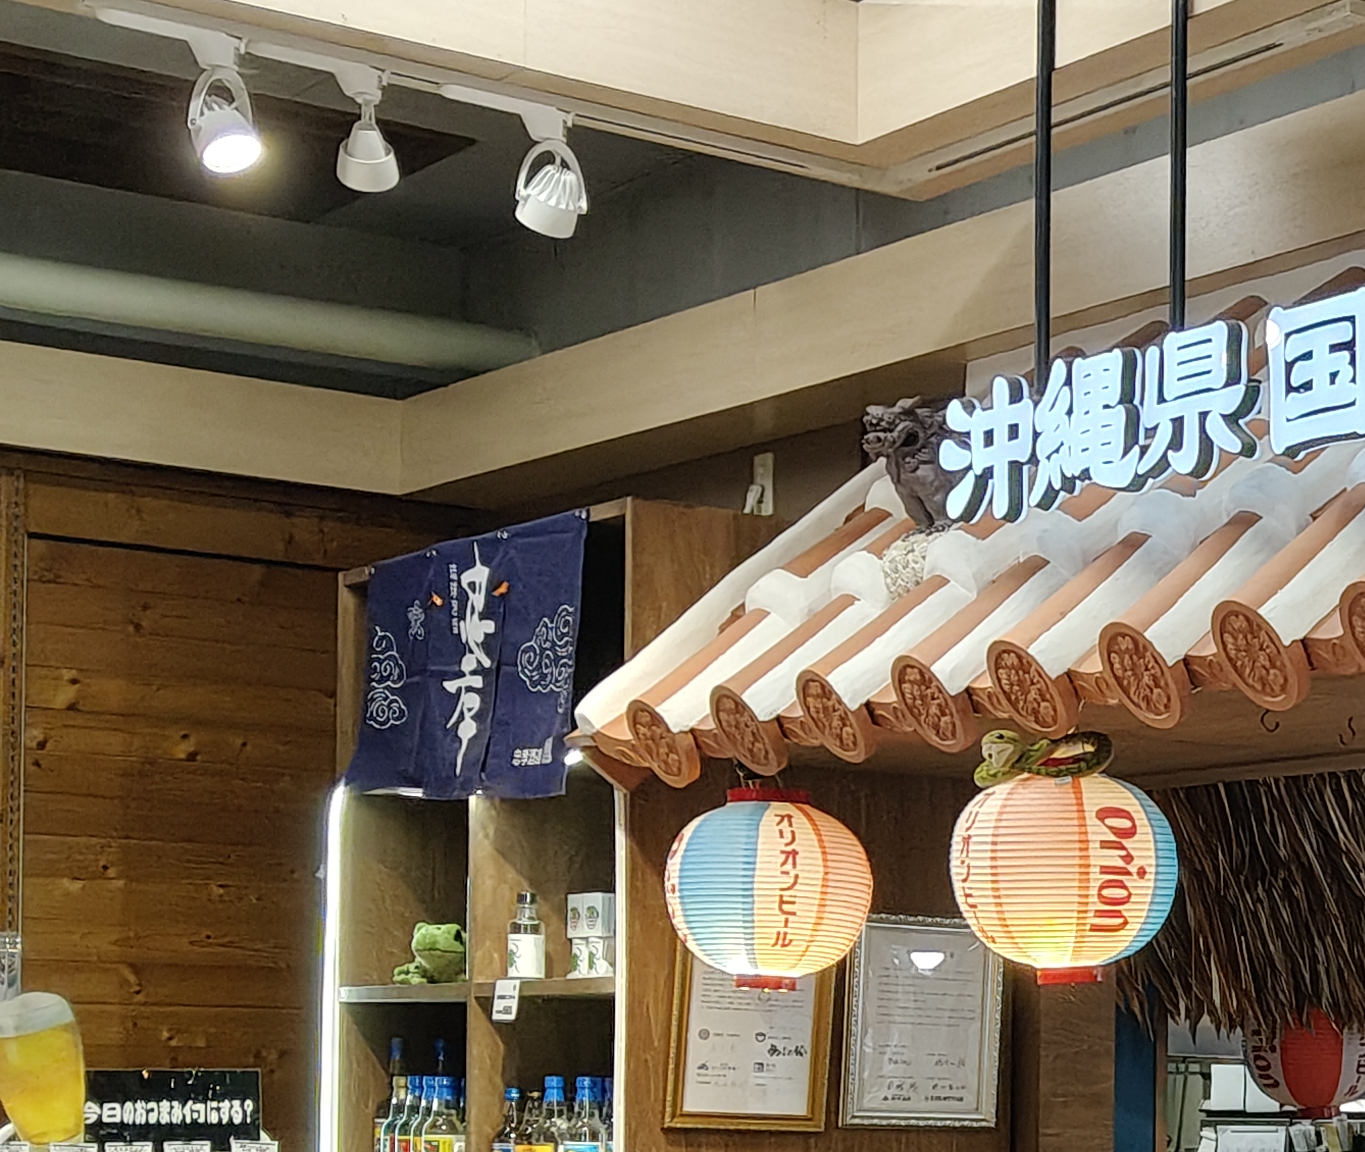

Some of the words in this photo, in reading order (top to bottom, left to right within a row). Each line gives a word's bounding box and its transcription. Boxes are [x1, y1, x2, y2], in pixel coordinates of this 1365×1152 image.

[938, 318, 1256, 524] 沖縄県
[770, 811, 800, 950] オリオンビール
[1088, 805, 1149, 935] Orion
